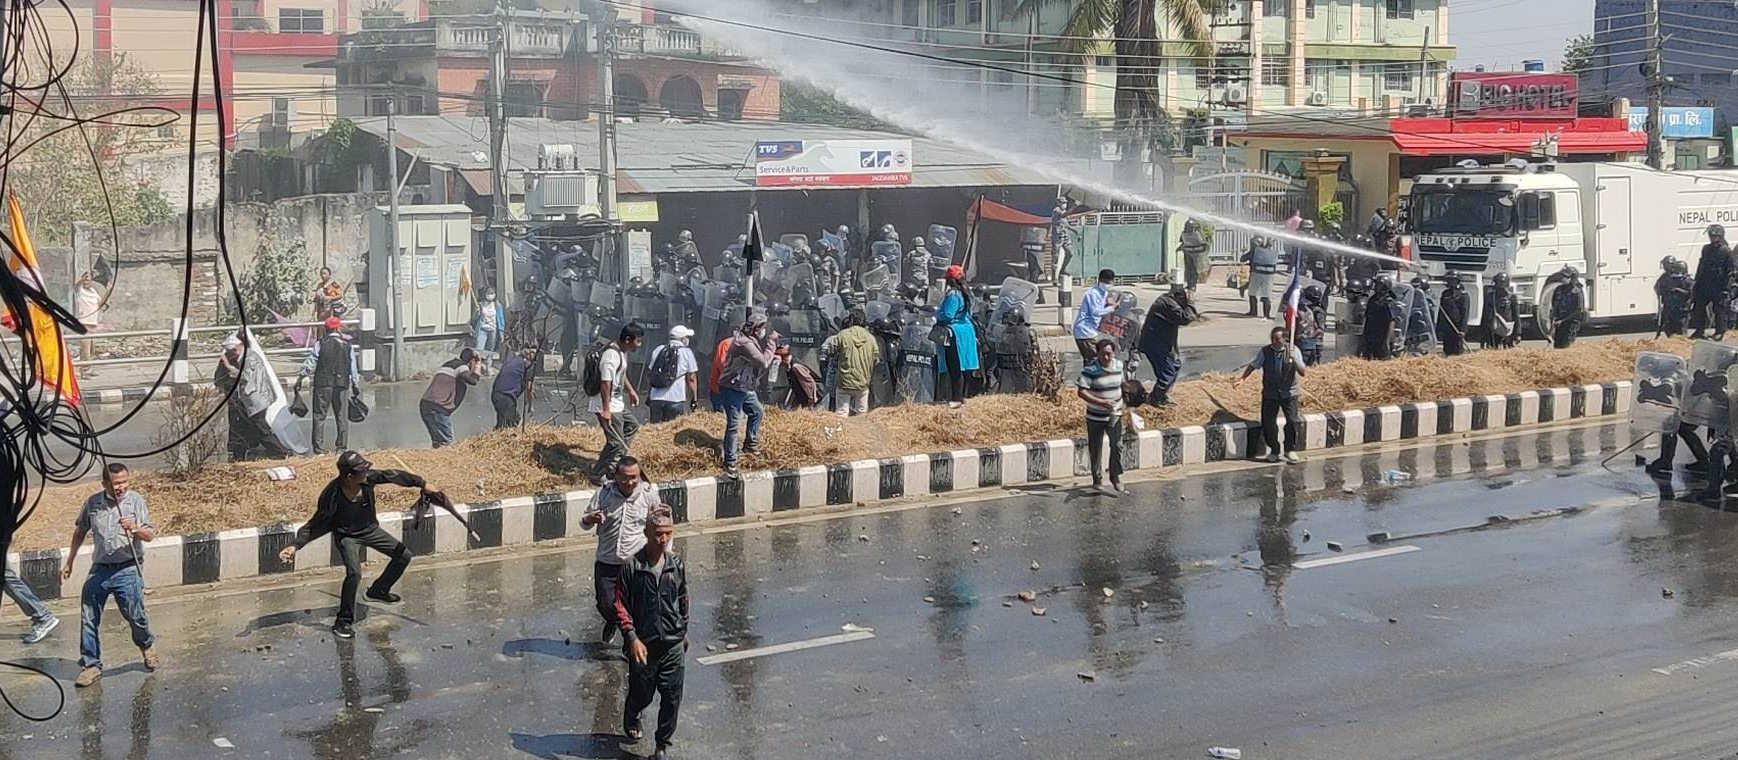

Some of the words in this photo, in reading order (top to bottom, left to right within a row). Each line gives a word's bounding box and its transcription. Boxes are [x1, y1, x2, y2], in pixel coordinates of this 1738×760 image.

[1512, 83, 1573, 111] HOTEL
[758, 144, 778, 154] TVS
[1679, 211, 1711, 224] NEPAL
[1458, 237, 1497, 247] POLICE
